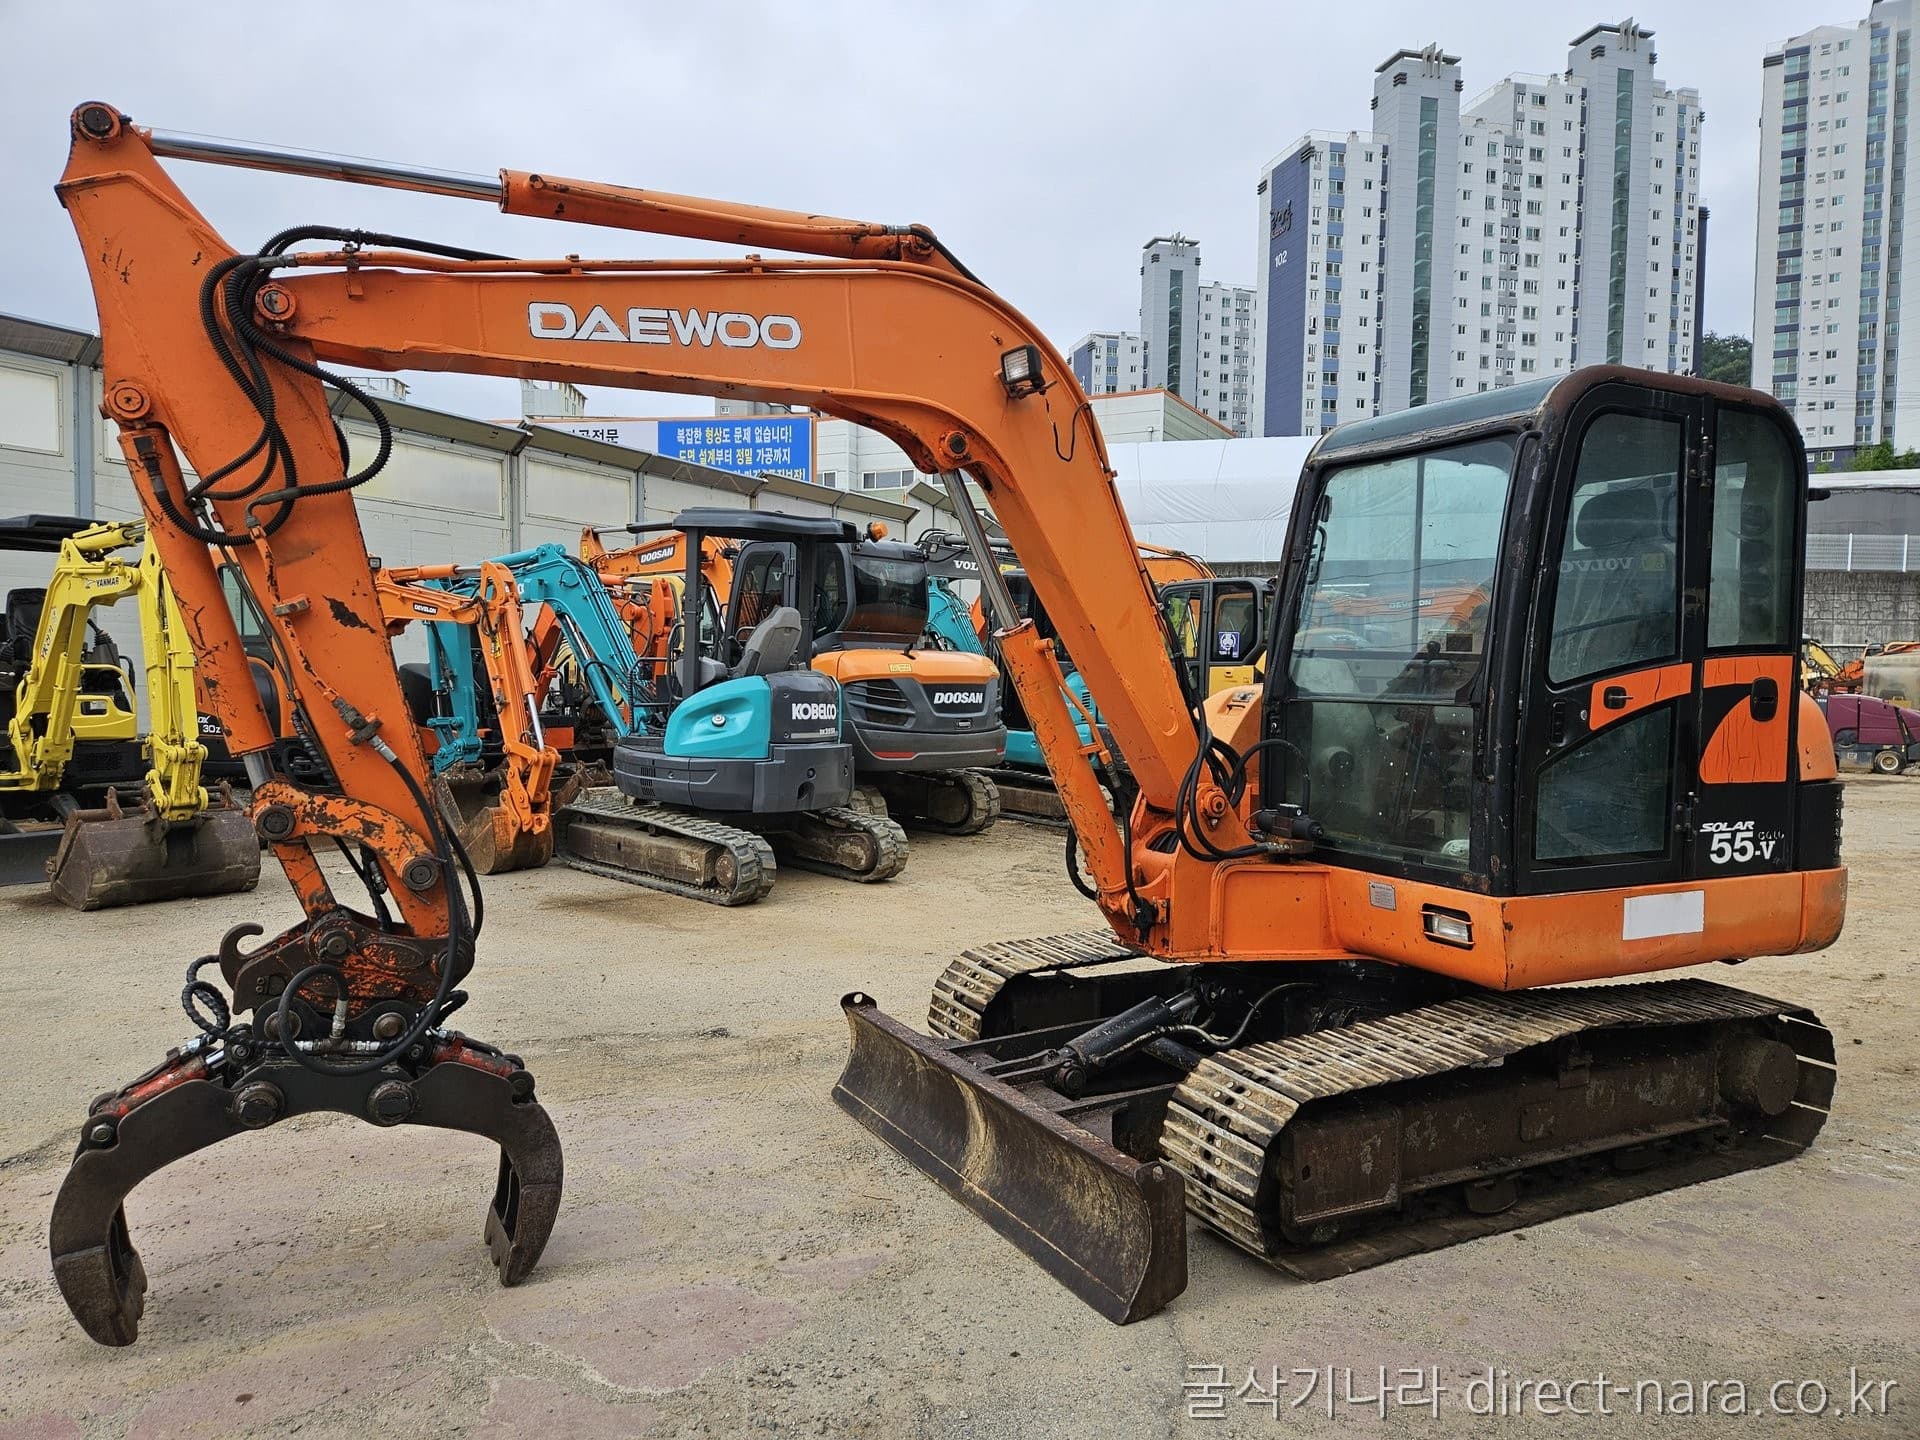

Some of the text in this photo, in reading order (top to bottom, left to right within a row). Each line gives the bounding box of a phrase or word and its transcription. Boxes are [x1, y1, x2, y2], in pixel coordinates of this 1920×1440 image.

[1275, 250, 1288, 267] 102
[528, 301, 802, 349] DAEWOO
[677, 425, 792, 445] 복잡한 형상도 문제 없습니다!
[699, 448, 732, 465] 설계부터
[736, 447, 753, 465] 정밀
[756, 447, 791, 465] 가공까지
[640, 546, 674, 563] DOOSAN
[96, 576, 120, 587] YANMAR
[934, 692, 983, 704] DOOSAN
[792, 703, 837, 720] KOBELCO
[1700, 821, 1755, 833] SOLAR
[1709, 831, 1776, 864] 55-V
